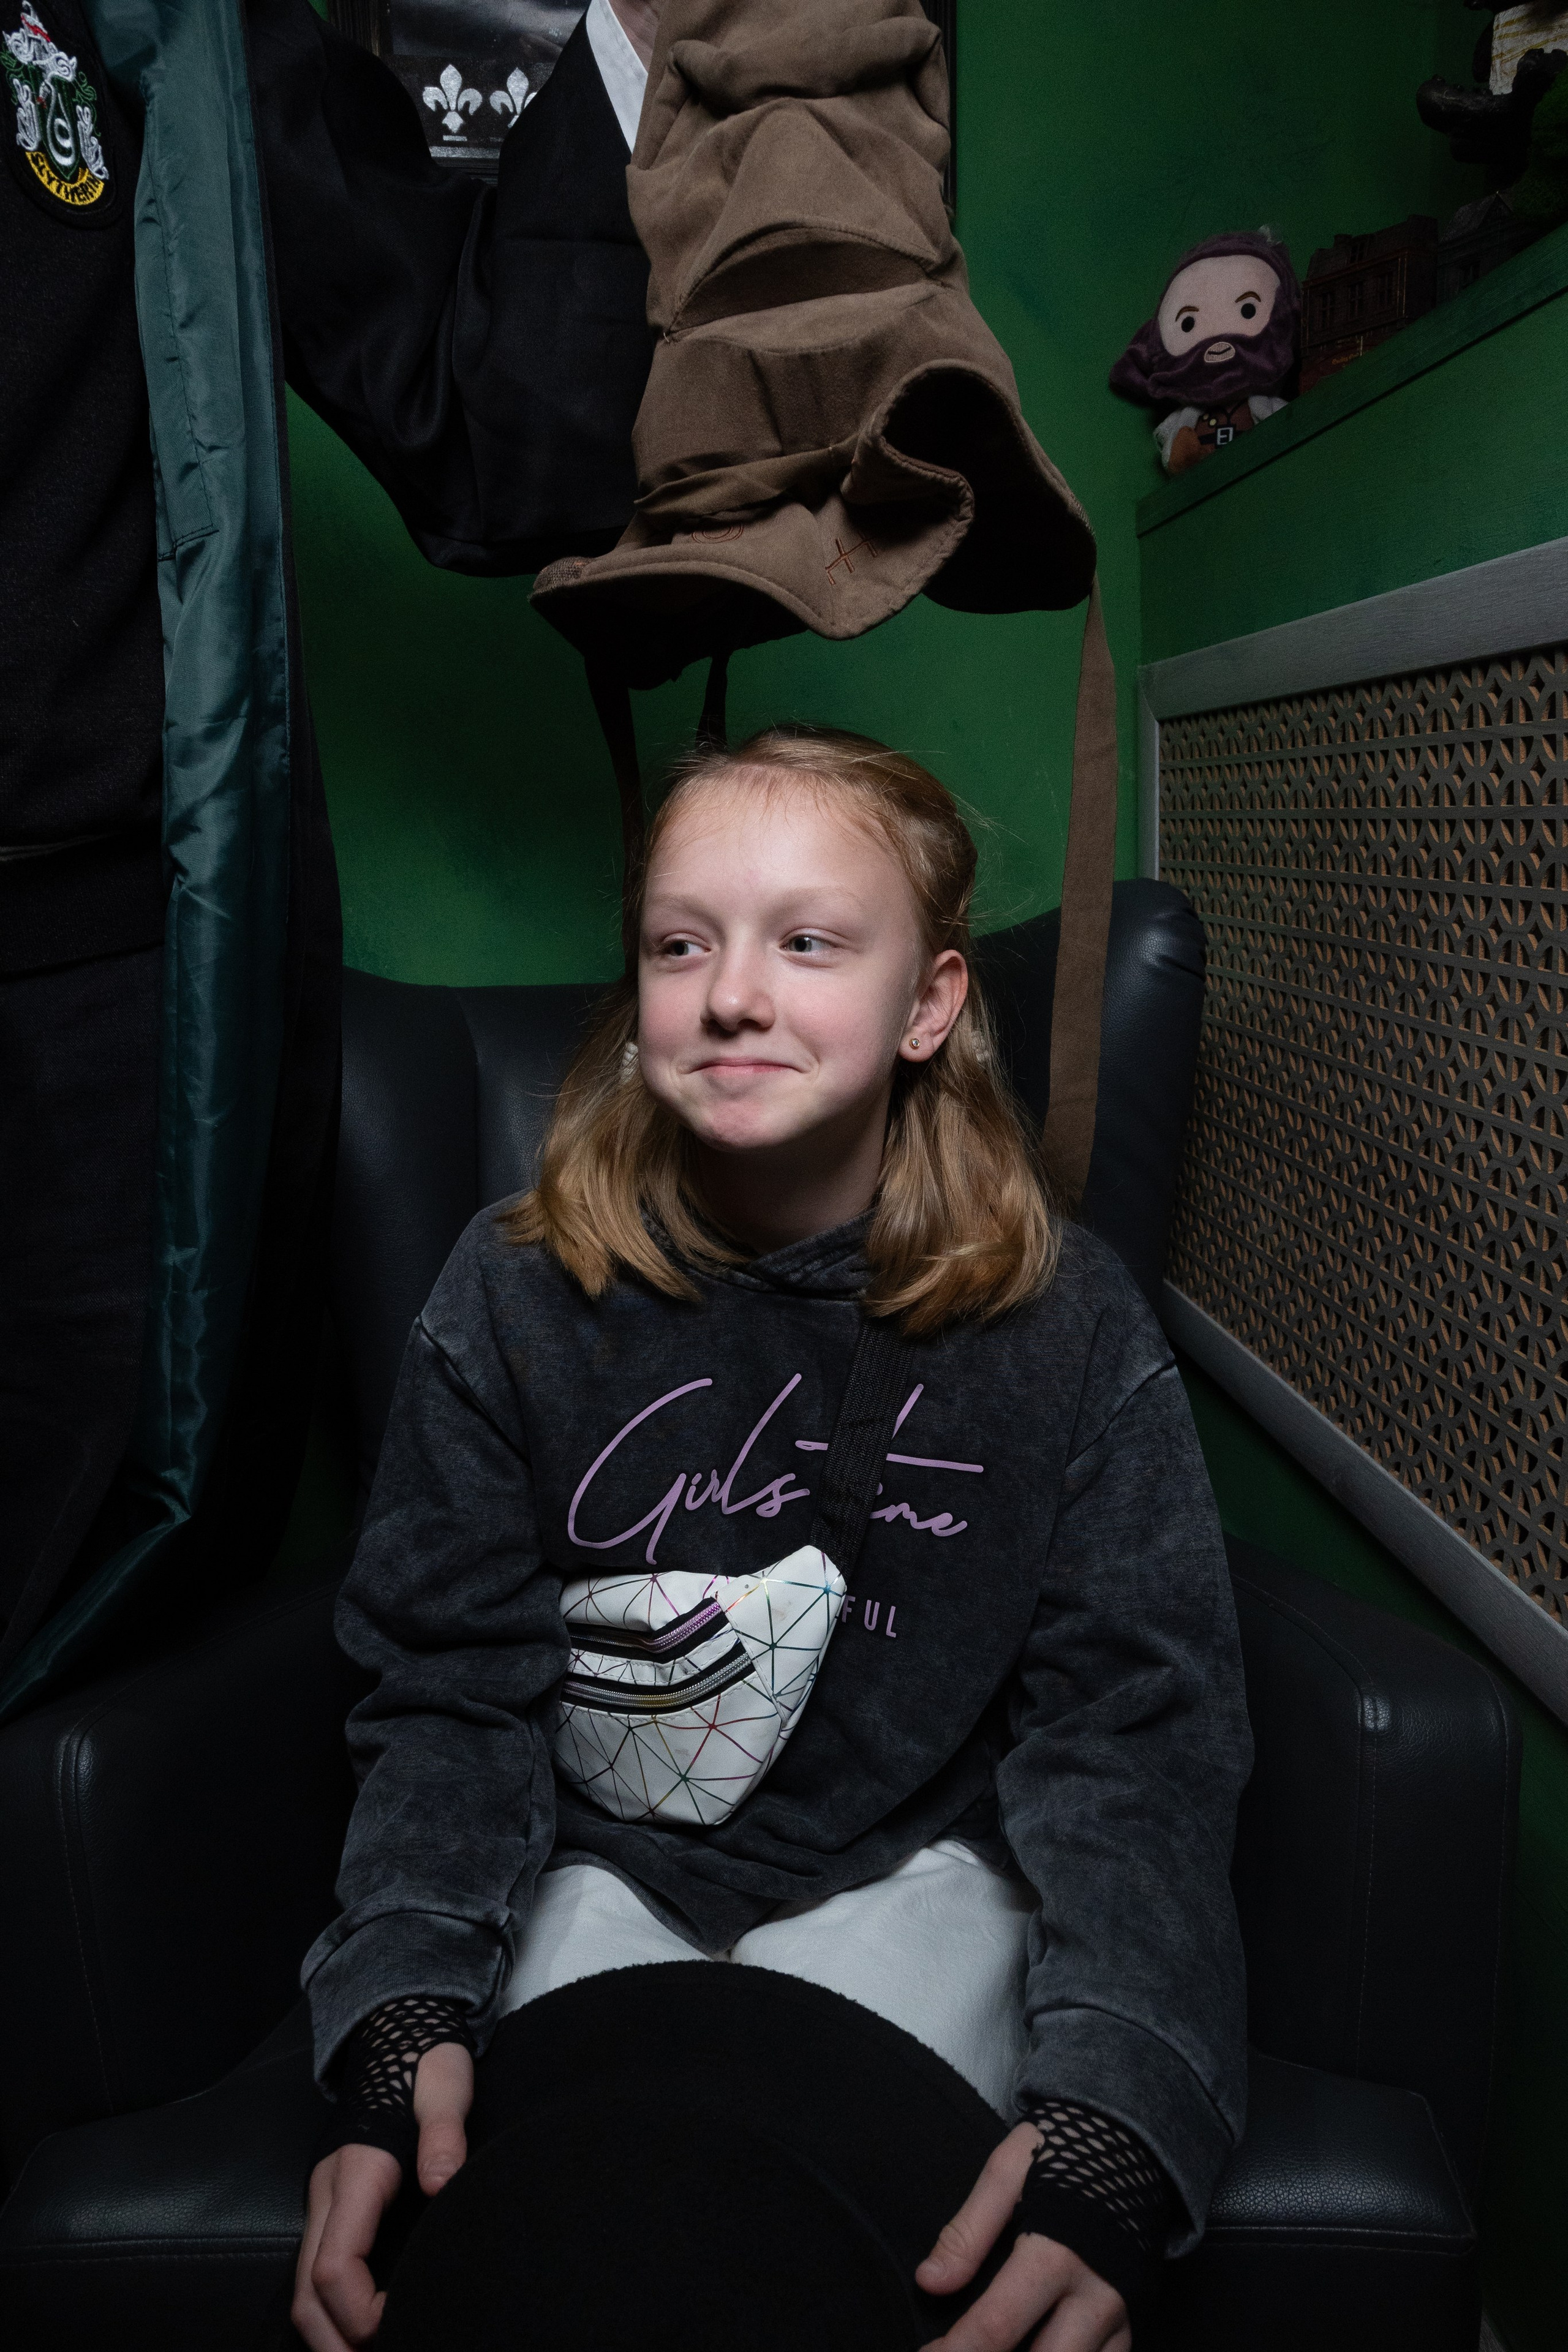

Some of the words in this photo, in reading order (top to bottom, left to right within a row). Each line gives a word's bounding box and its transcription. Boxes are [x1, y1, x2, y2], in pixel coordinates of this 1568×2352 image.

[30, 153, 101, 203] SLYTHERIN
[568, 1373, 810, 1565] Girls
[795, 1383, 984, 1537] tme
